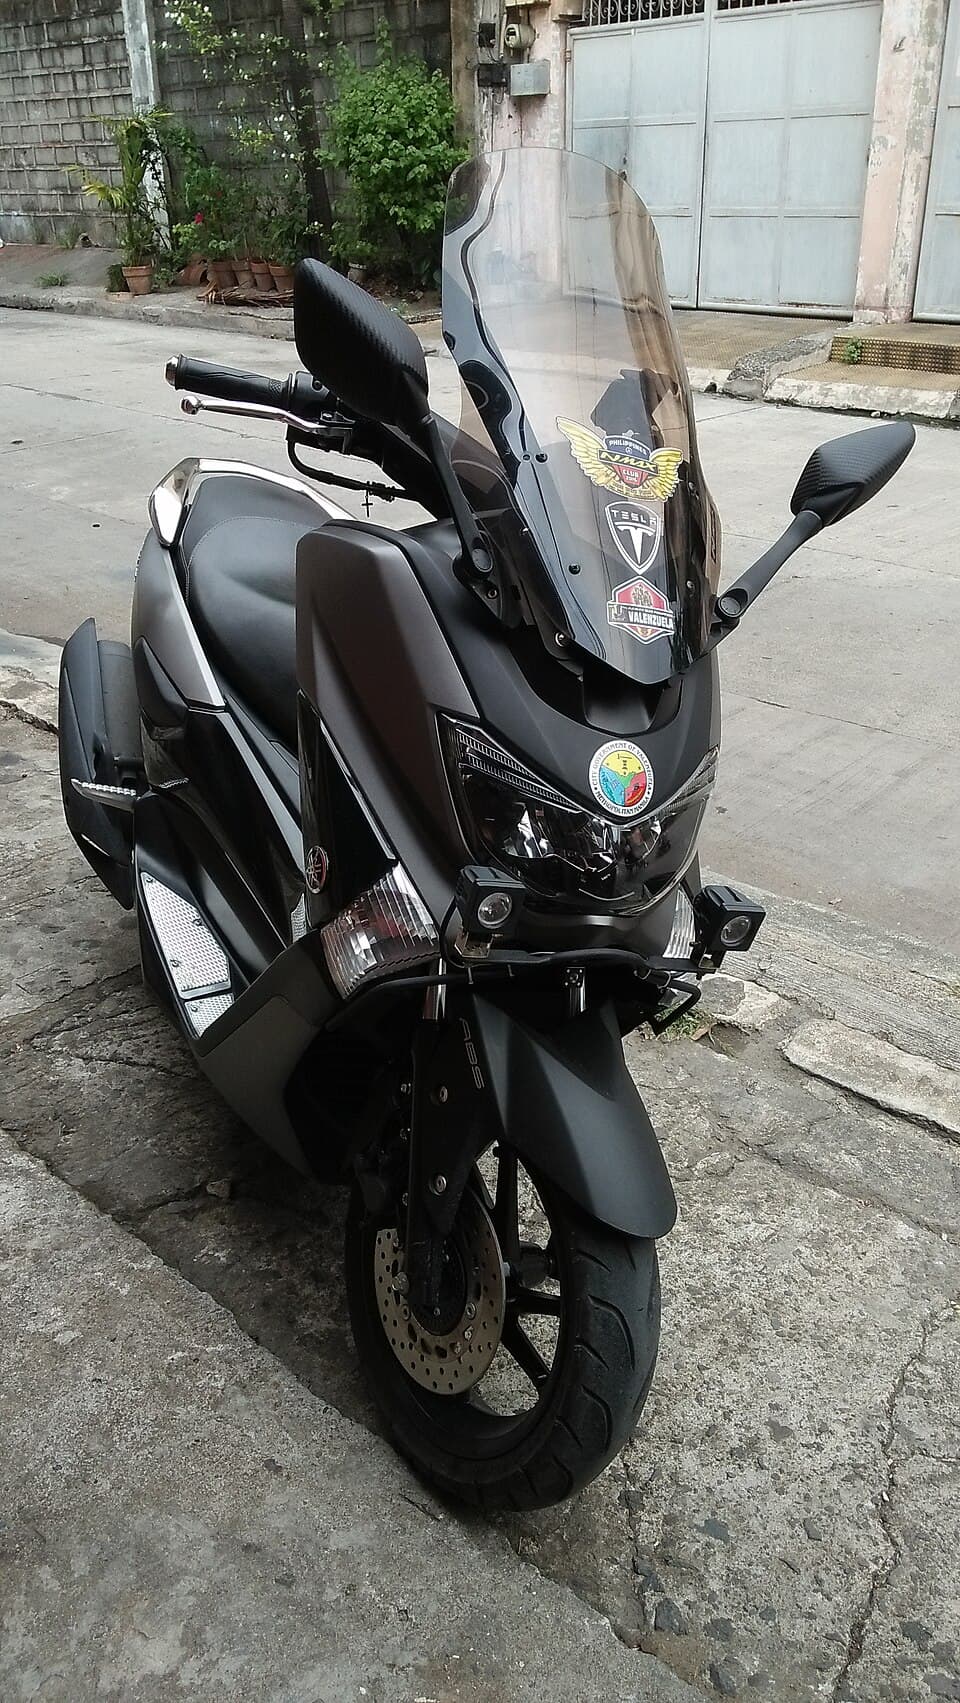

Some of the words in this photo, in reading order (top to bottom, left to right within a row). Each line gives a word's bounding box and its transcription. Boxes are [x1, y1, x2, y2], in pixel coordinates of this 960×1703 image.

[608, 439, 648, 456] PHILIPPINES
[600, 451, 657, 472] NMAX
[611, 510, 657, 526] TESLA
[628, 610, 674, 630] VALENZUELA
[627, 743, 636, 752] OF
[459, 1016, 485, 1089] ABS
